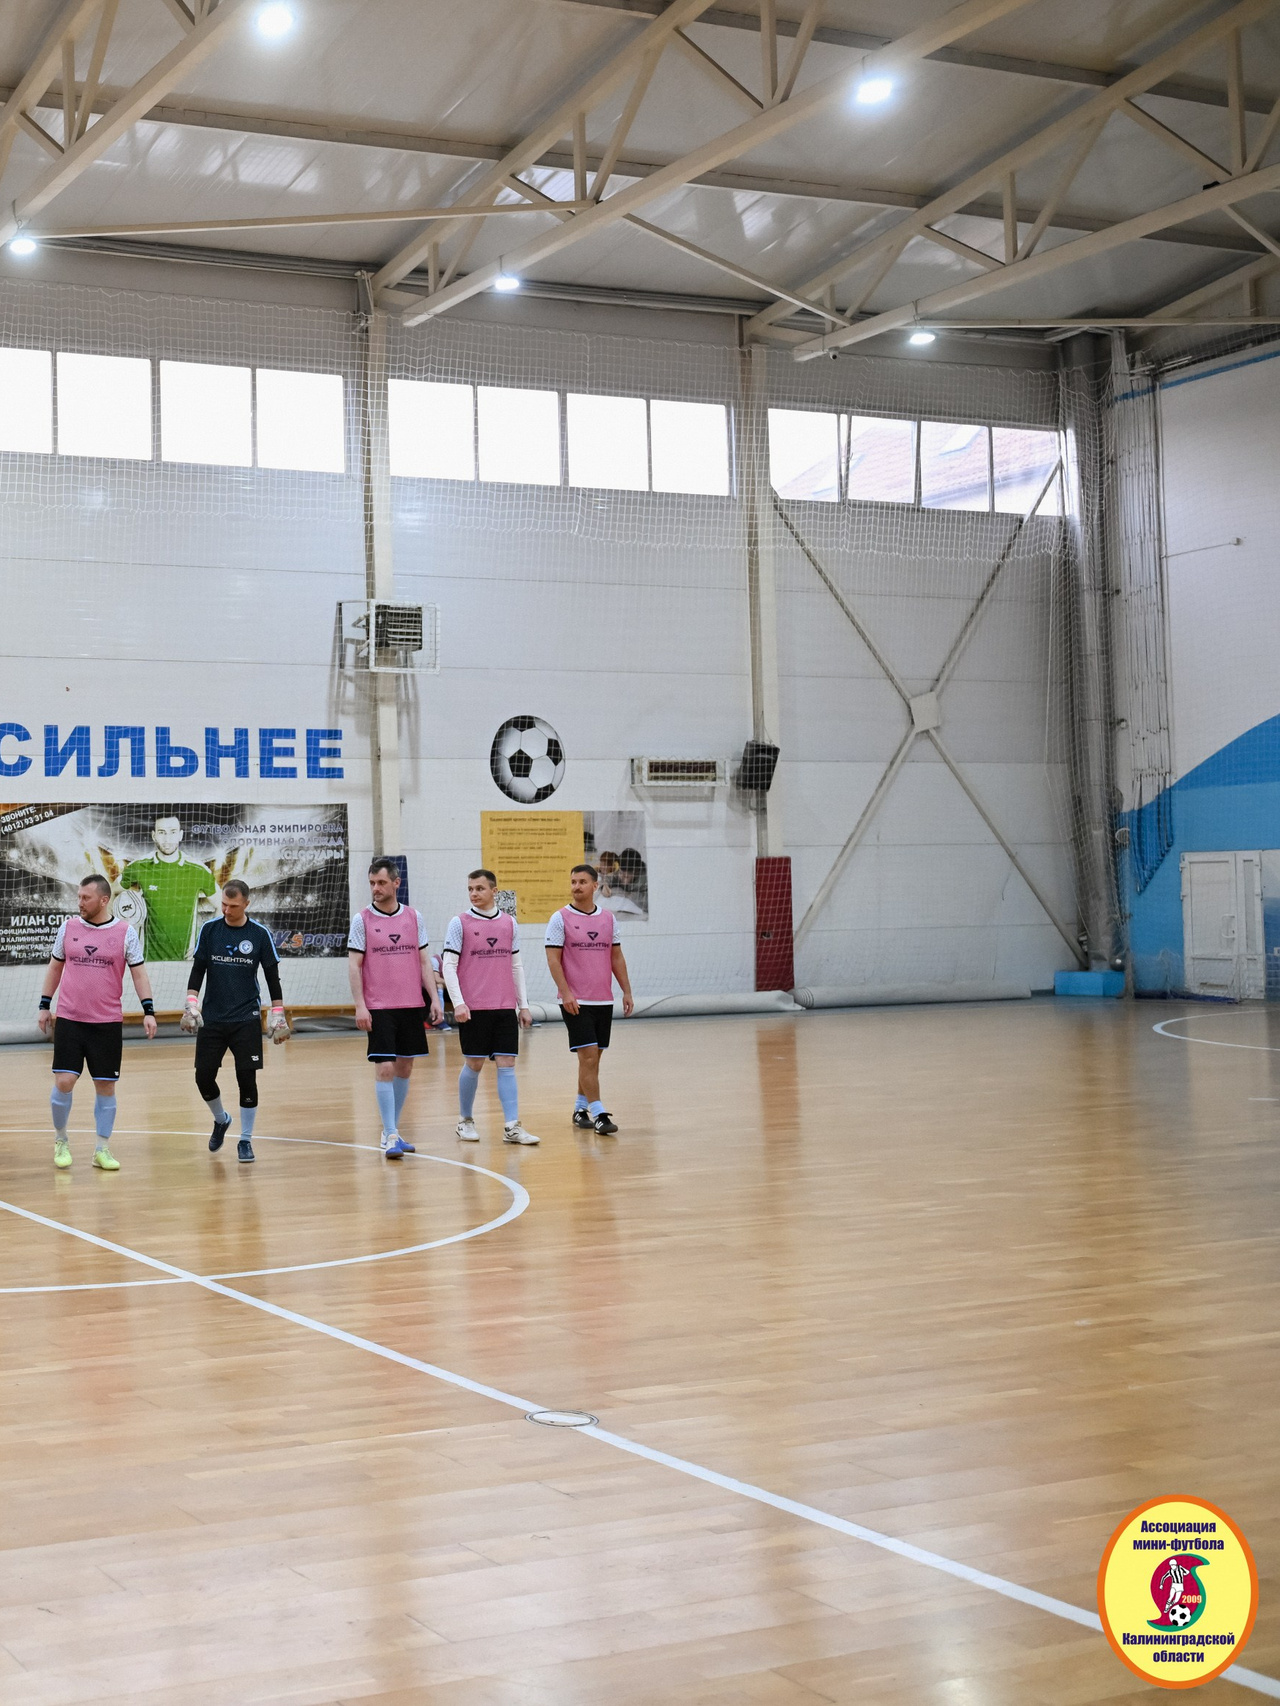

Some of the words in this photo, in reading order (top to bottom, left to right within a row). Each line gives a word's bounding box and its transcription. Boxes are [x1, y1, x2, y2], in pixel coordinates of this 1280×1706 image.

[1, 806, 37, 823] ЗВОНИТЕ:
[1, 820, 24, 835] (4012)
[192, 824, 266, 834] ФУТБОЛЬНАЯ
[269, 823, 345, 833] ЭКИПИРОВКА
[222, 837, 294, 847] СПОРТИВНАЯ
[11, 915, 45, 927] ИЛАН
